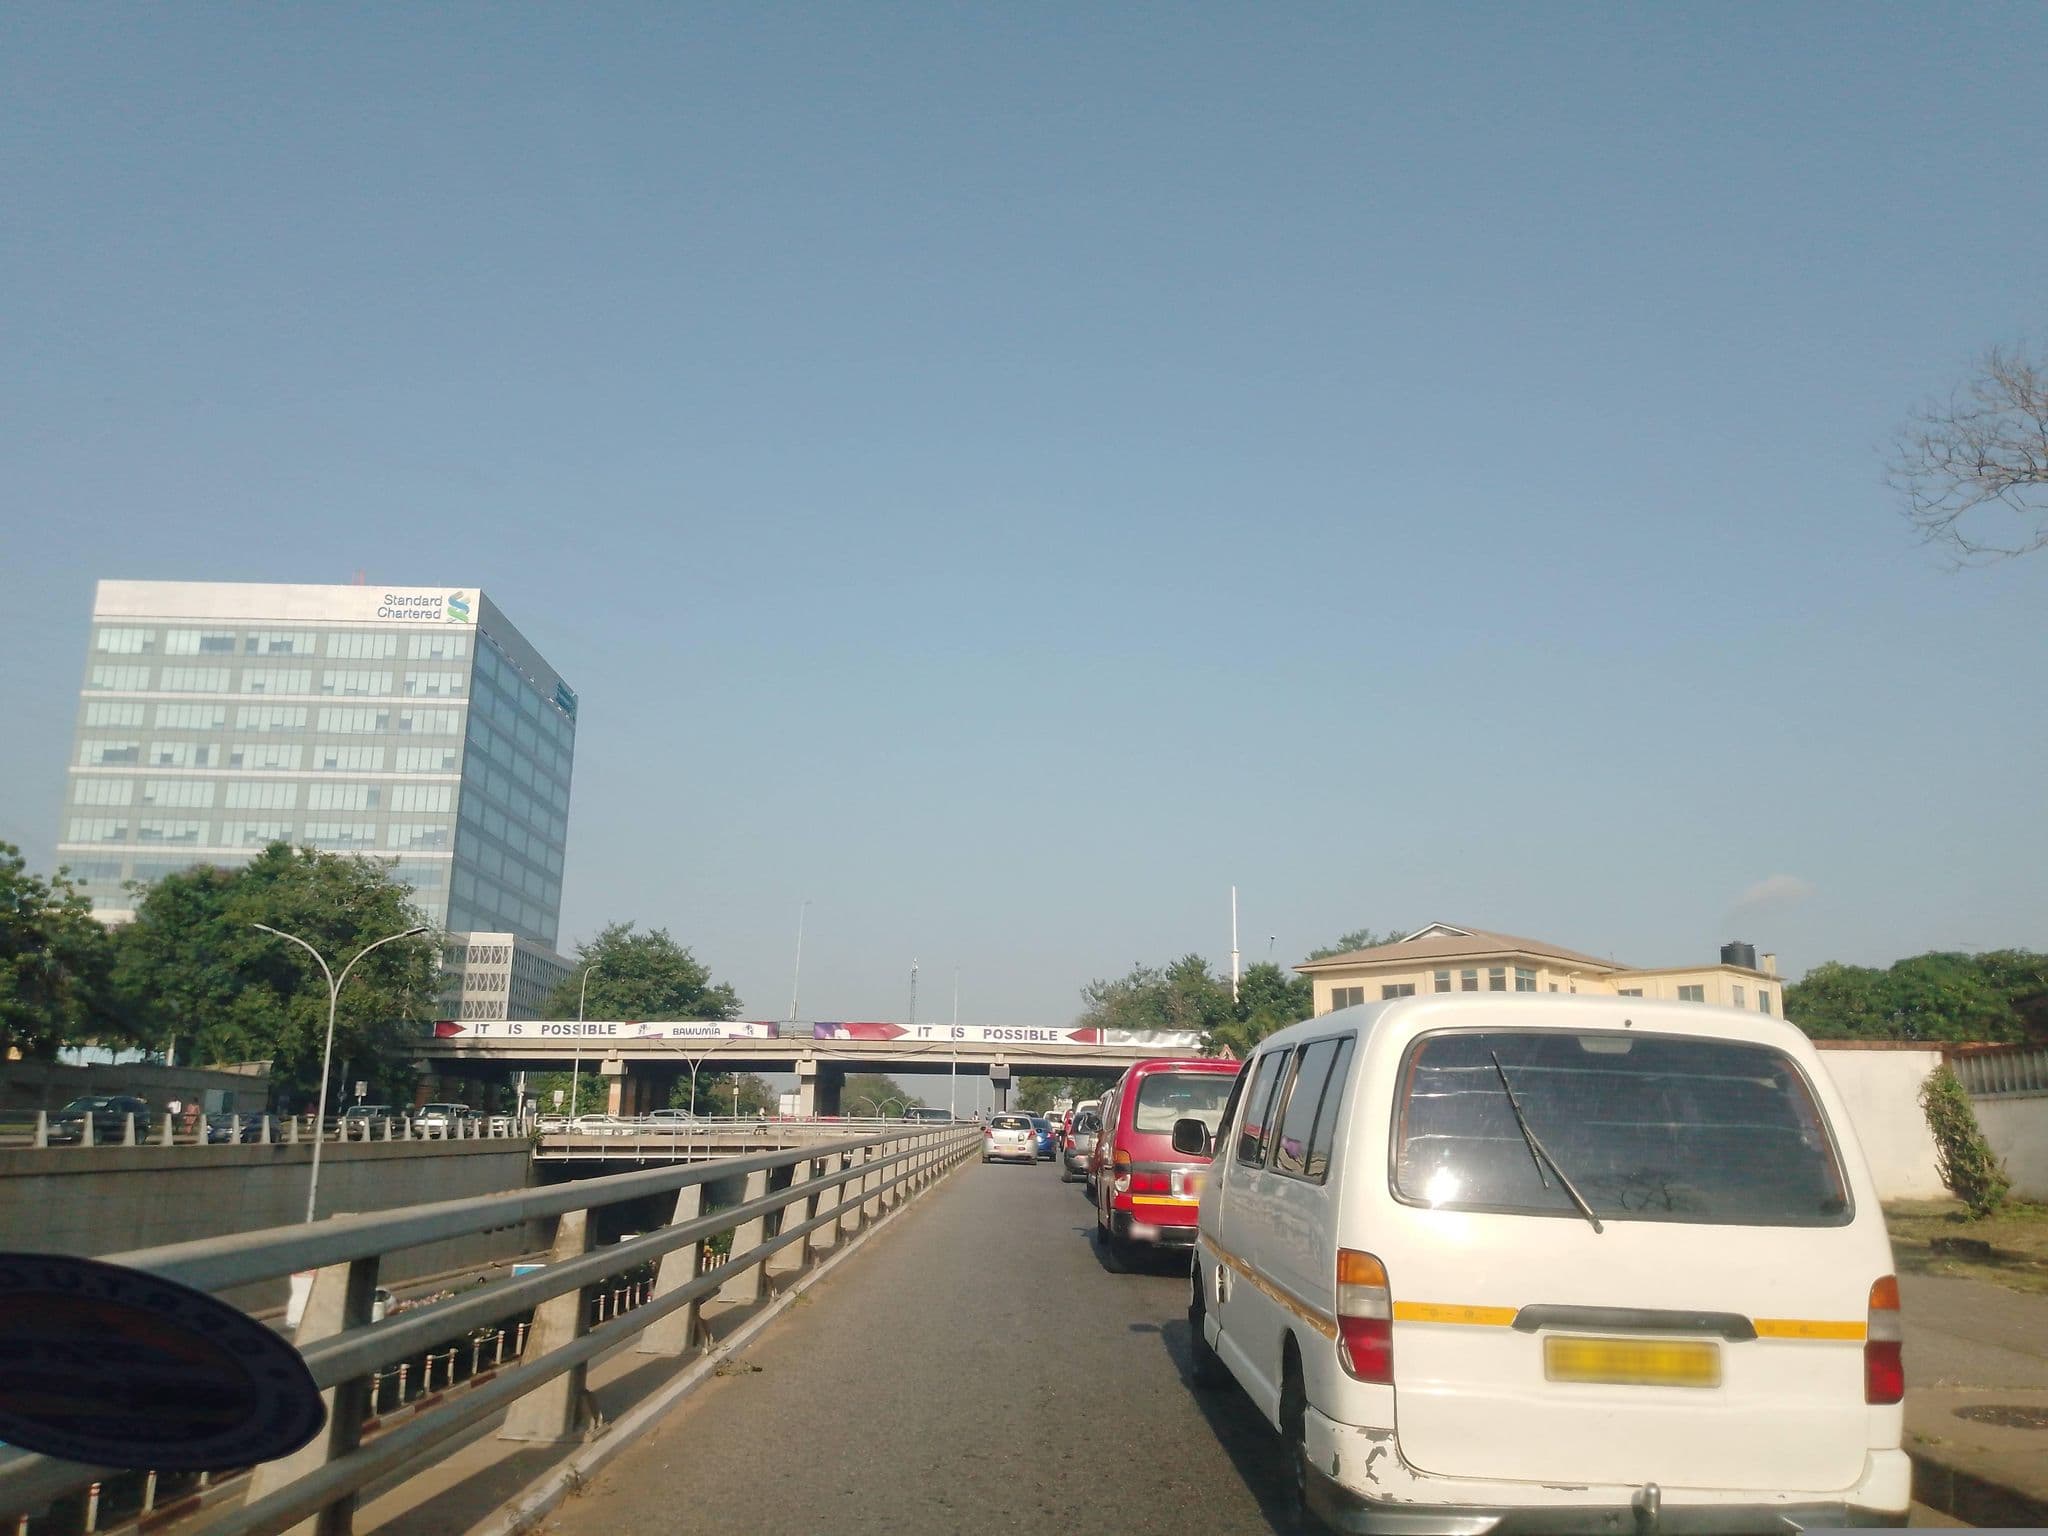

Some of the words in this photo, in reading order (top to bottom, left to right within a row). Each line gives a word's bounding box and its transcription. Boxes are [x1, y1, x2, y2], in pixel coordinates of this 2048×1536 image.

[384, 594, 443, 607] Standard
[377, 606, 441, 619] Chartered
[475, 1024, 490, 1034] IT
[508, 1024, 523, 1035] IS
[541, 1024, 617, 1035] POSSIBLE
[917, 1026, 932, 1038] IT
[951, 1027, 965, 1038] IS
[983, 1028, 1058, 1041] POSSIBLE
